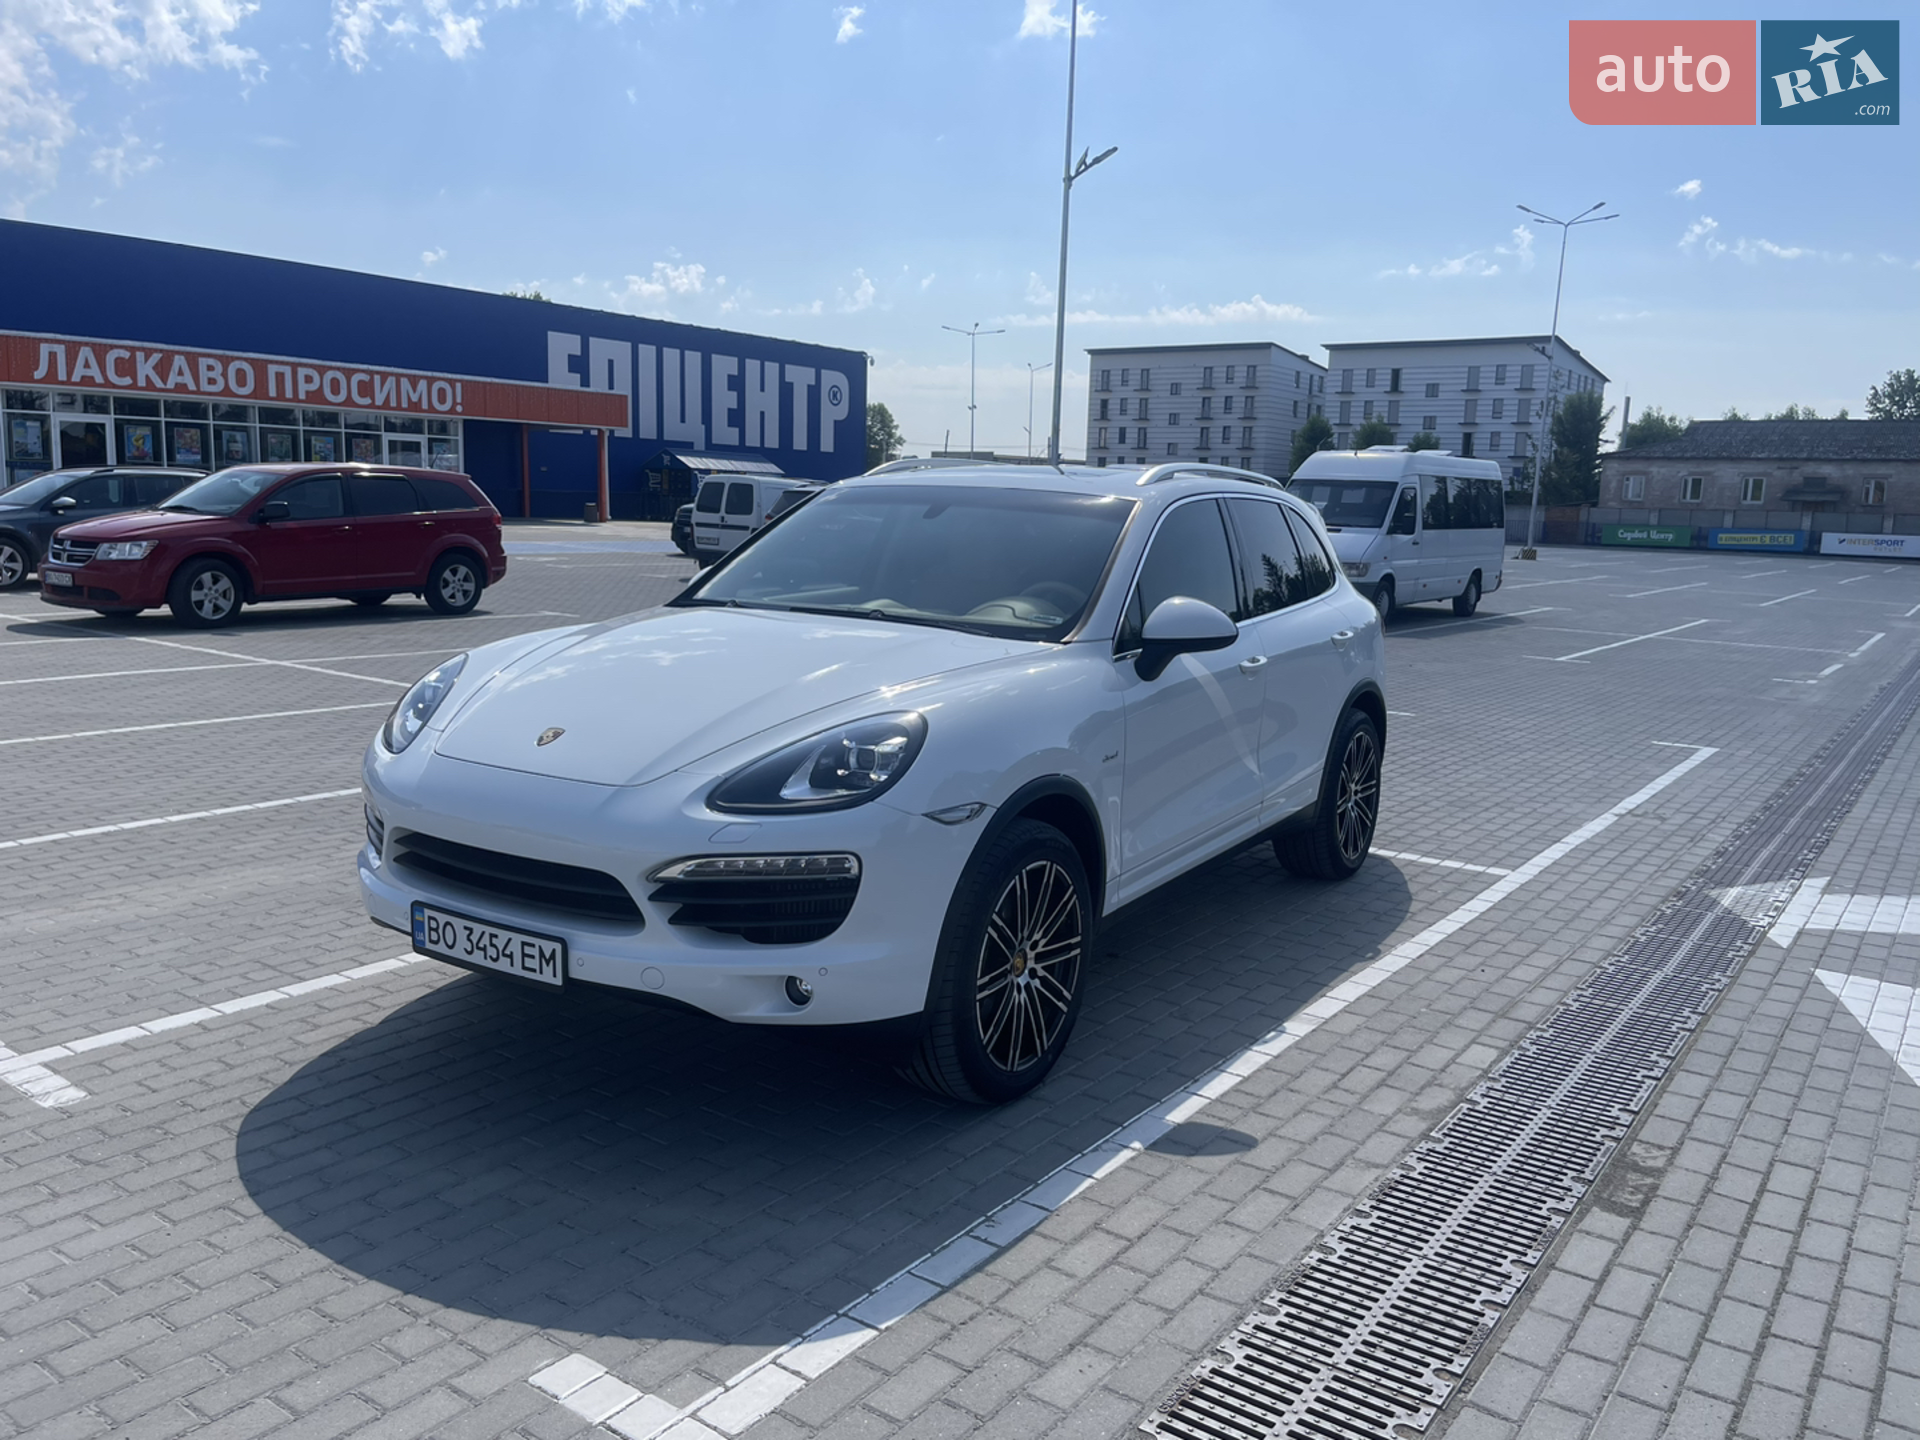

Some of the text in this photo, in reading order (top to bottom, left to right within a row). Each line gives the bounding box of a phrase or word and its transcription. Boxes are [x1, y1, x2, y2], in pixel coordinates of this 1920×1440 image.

[33, 342, 464, 413] ЛАСКАВО ПРОСИМО!
[1846, 538, 1905, 547] INTERSPORT
[415, 931, 425, 942] UA
[427, 915, 557, 978] BO 3454 EM
